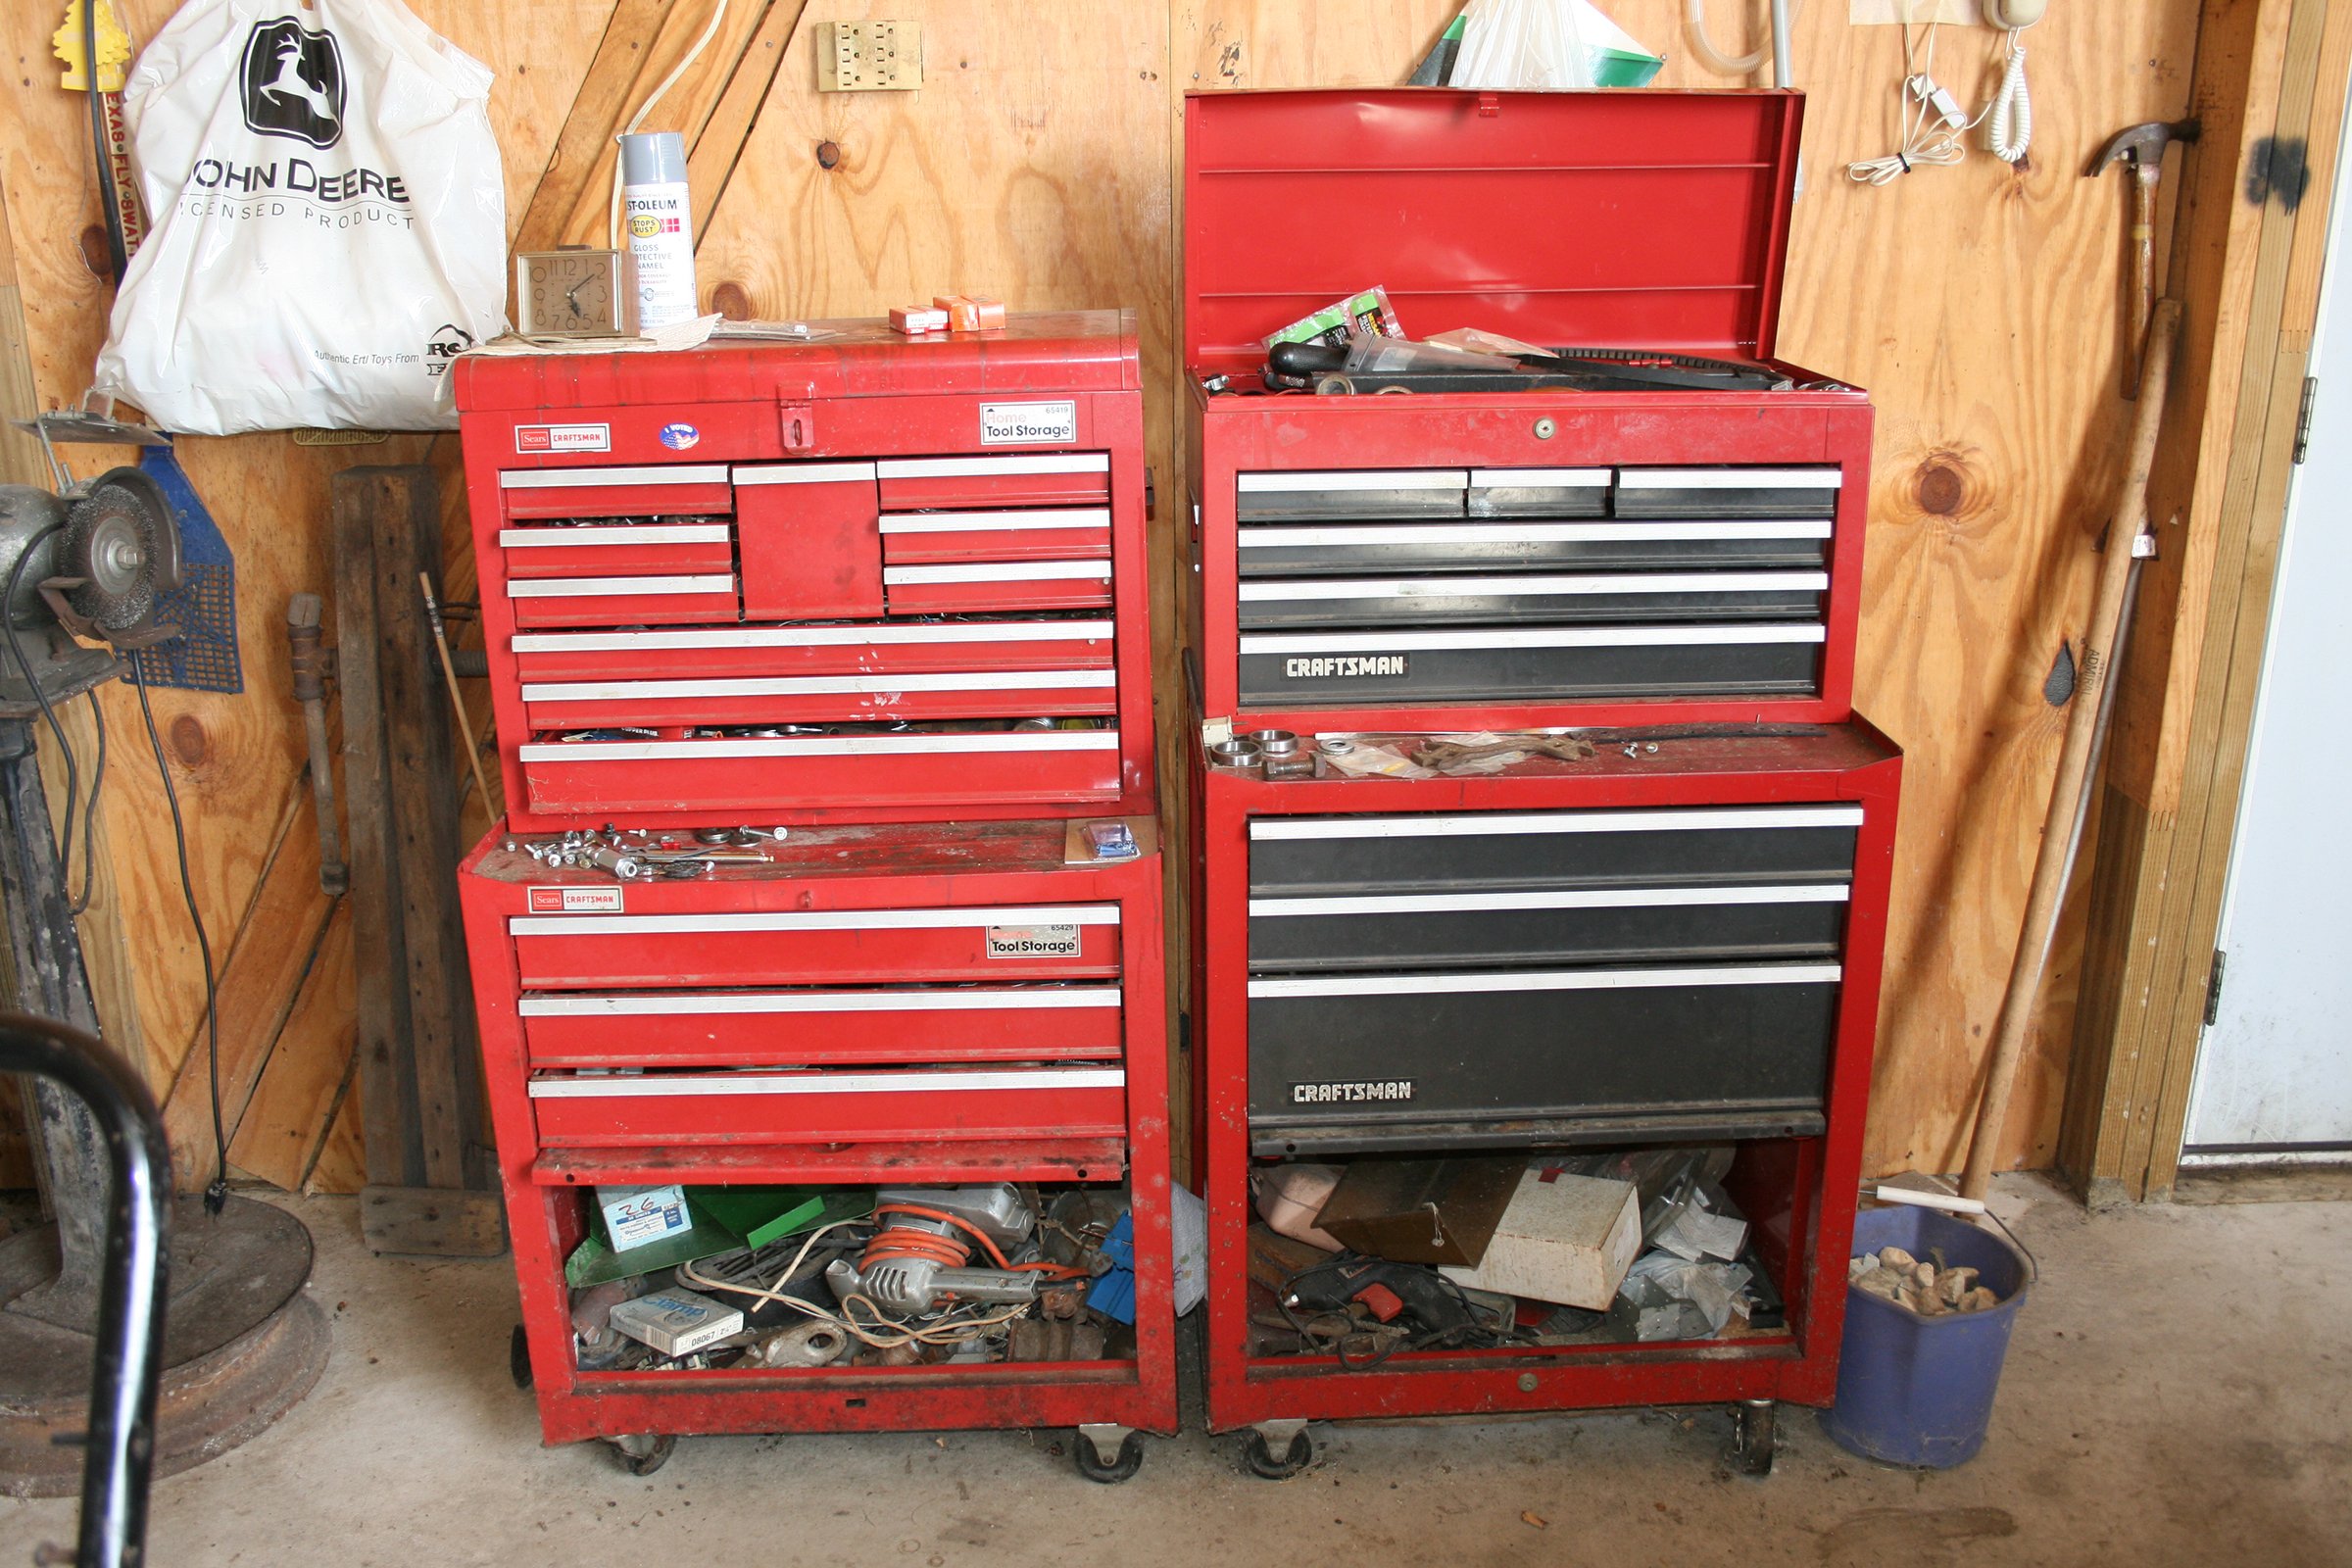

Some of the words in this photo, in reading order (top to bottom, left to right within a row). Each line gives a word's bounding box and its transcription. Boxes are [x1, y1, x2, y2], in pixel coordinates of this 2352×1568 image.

[106, 92, 125, 142] EXAS
[114, 153, 131, 188] FLY
[185, 158, 277, 193] OHN
[286, 158, 410, 203] DEERE
[179, 201, 285, 220] ICENSED
[305, 206, 415, 230] PRODUCT
[528, 265, 547, 283] 10
[549, 260, 558, 276] 11
[563, 259, 577, 276] 12
[595, 262, 607, 281] 2
[533, 287, 546, 305] 9
[595, 284, 608, 304] 3
[534, 308, 547, 326] 8
[551, 314, 561, 330] 7
[565, 314, 578, 331] 6
[582, 313, 593, 330] 5
[596, 308, 607, 324] 4
[371, 353, 393, 367] Toys
[394, 352, 419, 364] From
[986, 413, 1027, 424] Home
[1045, 406, 1069, 415] 65419
[669, 423, 694, 433] VOTED
[986, 424, 1013, 437] Tool
[1015, 424, 1070, 438] Storage
[523, 433, 547, 444] Sears
[553, 434, 601, 443] CRAFTSMAN
[1286, 656, 1404, 677] CRAFTSMAN
[535, 895, 560, 905] Sears
[992, 941, 1019, 952] Tool
[1021, 941, 1076, 954] Storage
[1294, 1081, 1411, 1102] CRAFTSMAN
[618, 1197, 655, 1215] 26
[641, 1295, 708, 1317] Clamp
[691, 1331, 716, 1348] 08067
